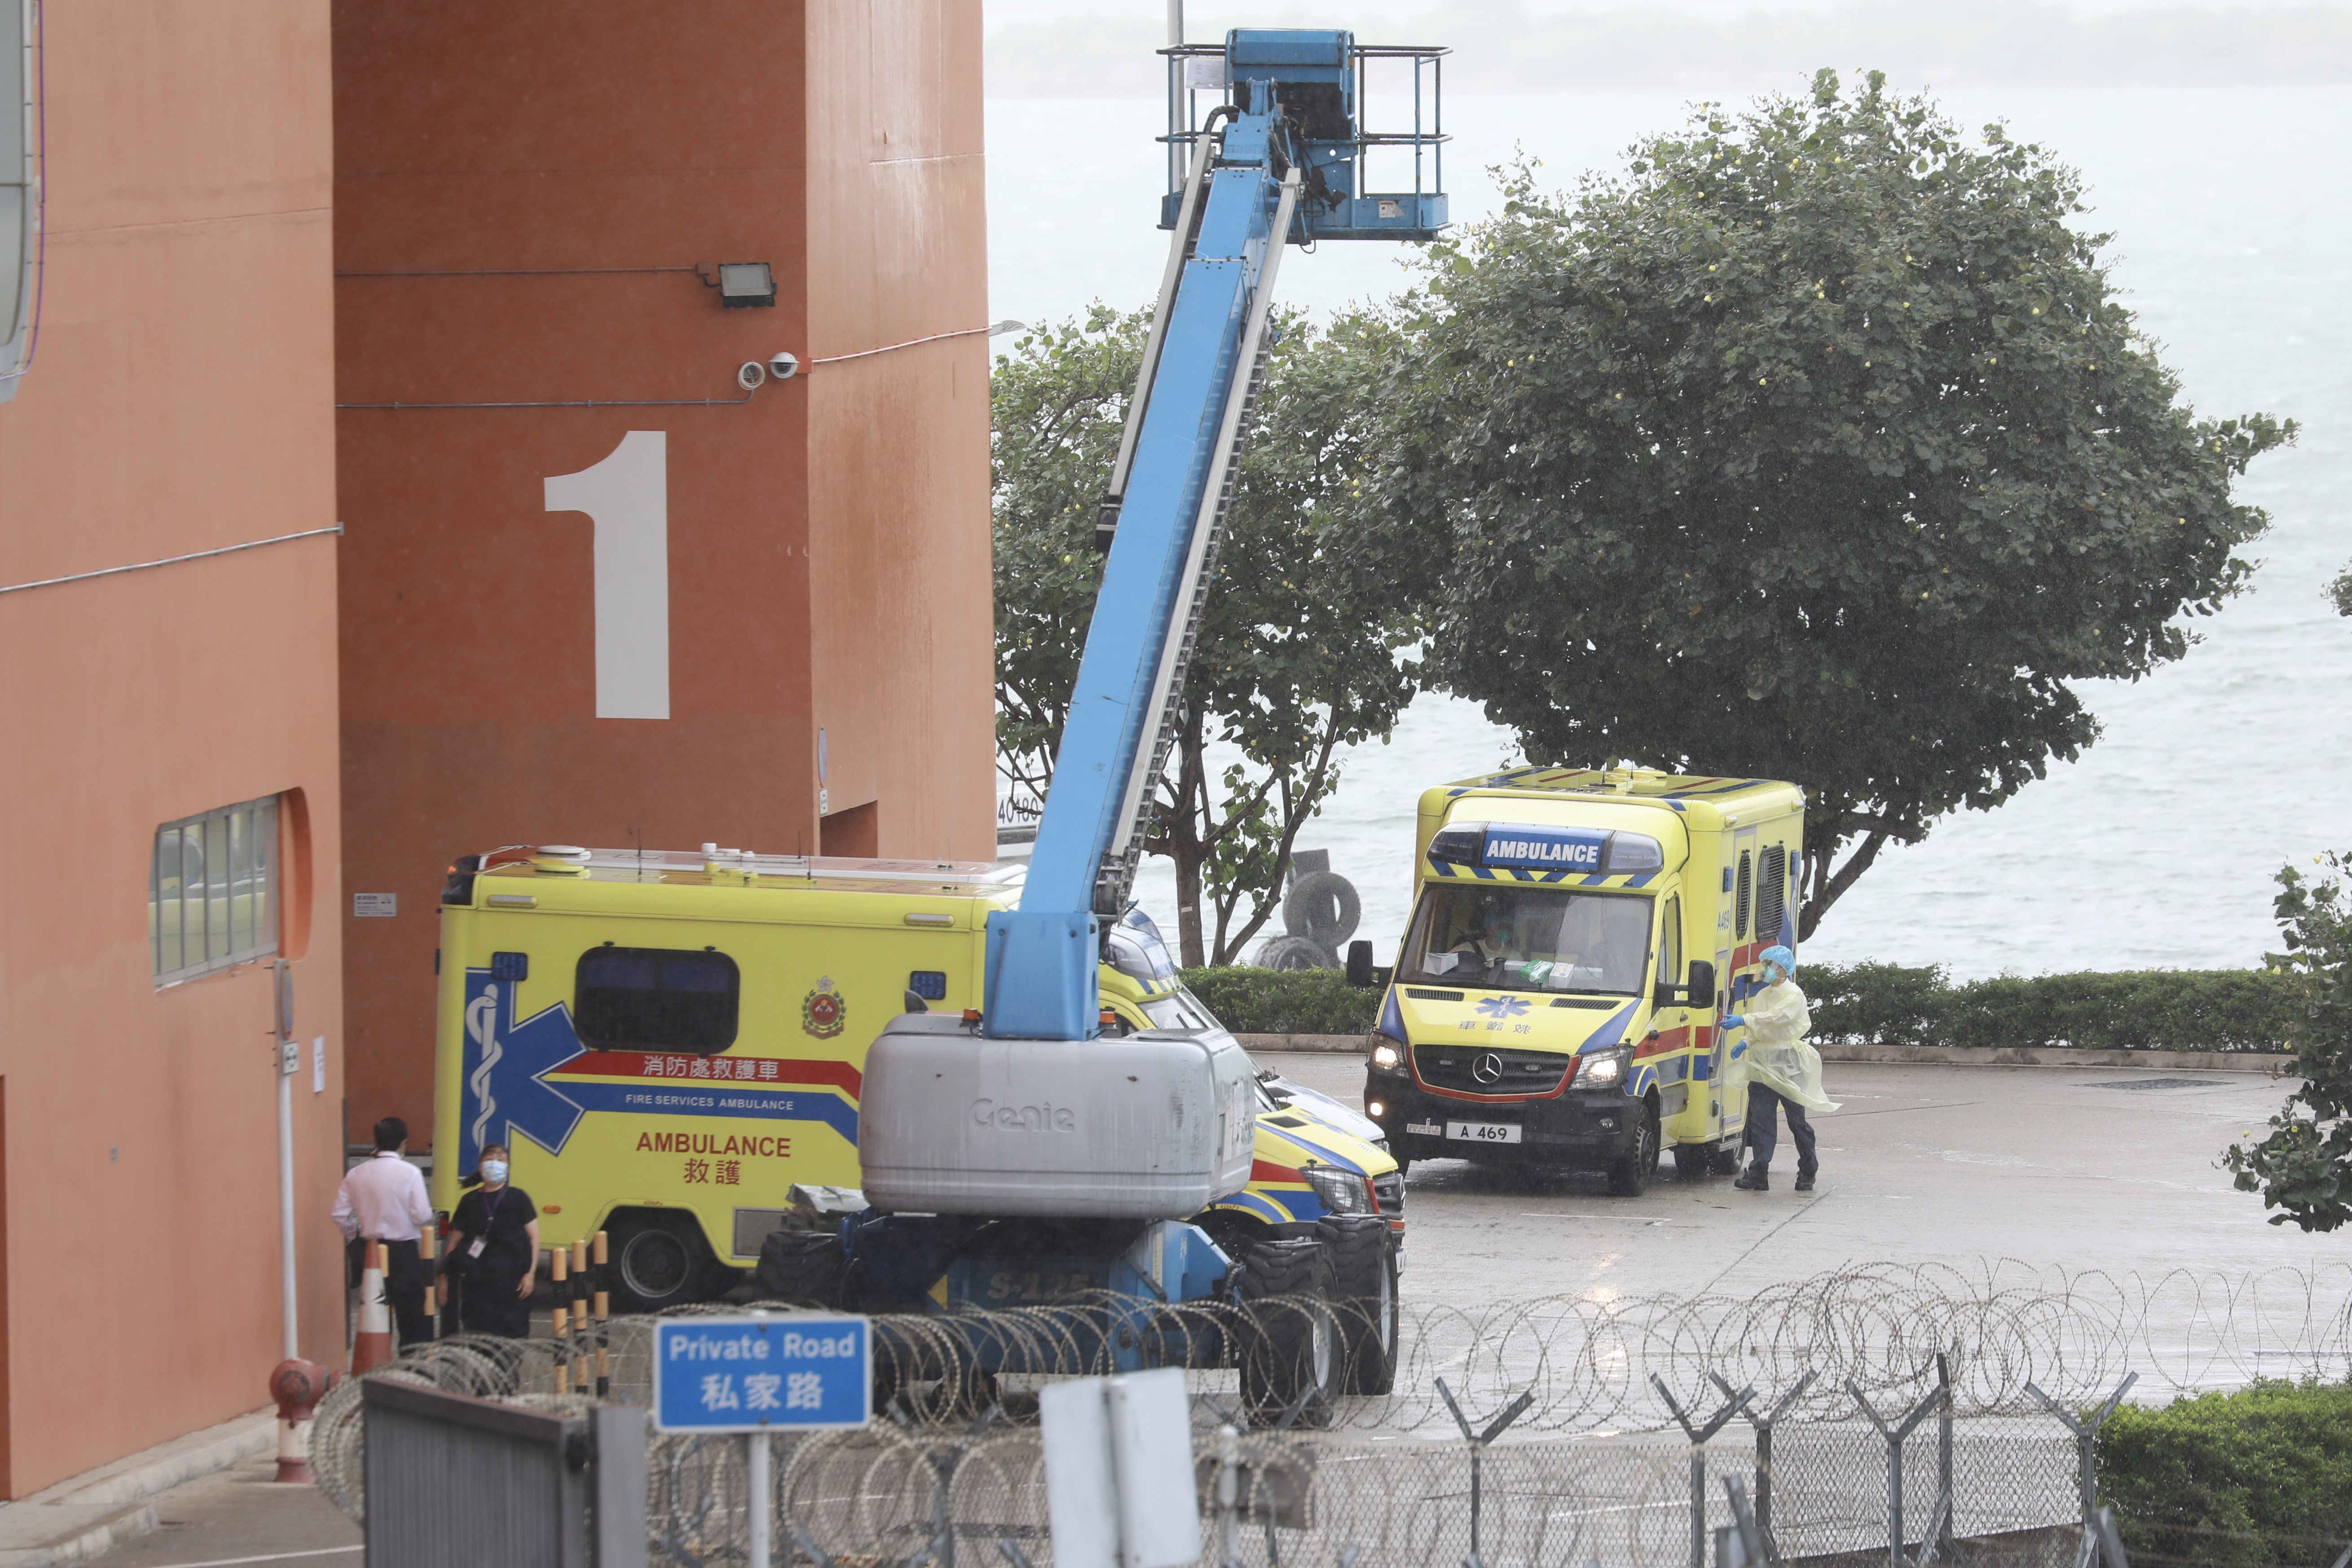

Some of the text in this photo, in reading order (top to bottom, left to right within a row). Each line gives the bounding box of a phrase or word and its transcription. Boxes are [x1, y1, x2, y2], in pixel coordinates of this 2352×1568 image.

[544, 430, 670, 719] 1
[1486, 840, 1599, 863] AMBULANCE
[1717, 909, 1729, 932] A469
[643, 1055, 779, 1080] 消防處救護車
[625, 1094, 794, 1110] FIRE SERVICES AMBULANCE
[969, 1098, 1075, 1132] Genie
[636, 1132, 791, 1158] AMBULANCE
[1460, 1125, 1507, 1140] A 469
[684, 1158, 741, 1185] 救護
[987, 1272, 1091, 1300] S-125
[669, 1332, 855, 1361] Private Road
[700, 1371, 824, 1412] 私家路
